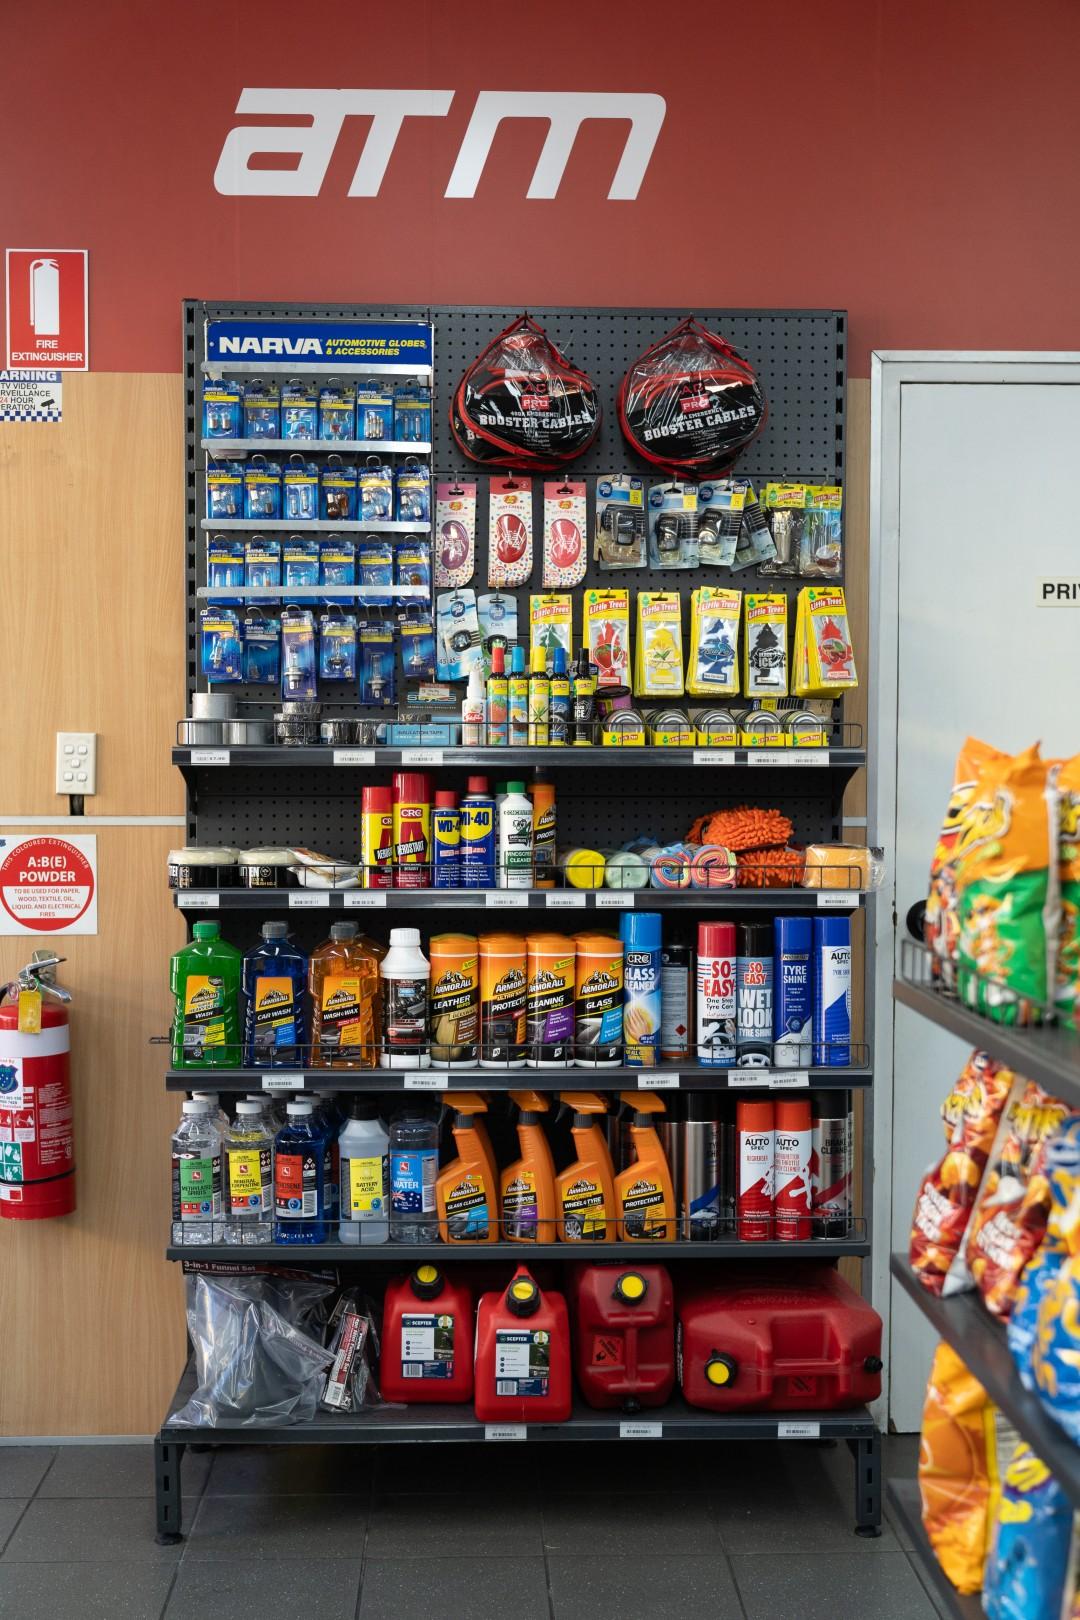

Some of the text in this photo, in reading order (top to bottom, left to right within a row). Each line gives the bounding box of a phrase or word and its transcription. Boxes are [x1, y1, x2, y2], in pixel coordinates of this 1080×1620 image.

[36, 340, 58, 349] FIRE
[219, 336, 323, 355] NARVA
[326, 339, 426, 348] AUTOMOTIVE GLOBES
[12, 352, 83, 362] EXTINGUISHER
[326, 347, 400, 356] & ACCESSORIES
[0, 370, 57, 382] ARNING
[523, 400, 549, 408] PRO
[479, 414, 593, 429] BOOSTER CABLES
[643, 405, 756, 442] BOOSTER CABLES
[589, 600, 626, 615] Little Trees
[642, 603, 678, 617] Little Trees
[701, 600, 739, 612] Little Trees
[810, 598, 843, 611] Little Trees
[532, 605, 571, 621] Little Trees
[748, 605, 786, 619] Little Trees
[574, 709, 585, 718] ICE
[401, 809, 422, 817] CRC
[382, 817, 392, 825] CR
[438, 819, 460, 833] WD-4
[2, 838, 90, 871] THIS COLOURED EXTINGUISHER
[27, 856, 67, 869] A:B(E)
[19, 871, 76, 883] POWDER
[627, 953, 651, 963] CRC
[624, 968, 655, 981] GLASS
[711, 961, 732, 979] SO
[749, 962, 764, 975] SO
[783, 965, 807, 975] TYRE
[624, 980, 656, 991] CLEANER
[744, 973, 767, 985] EASY
[783, 975, 807, 984] SHINE
[434, 979, 472, 994] ARMORALL
[495, 978, 527, 994] ARMORA
[528, 979, 564, 993] ARMORALL
[581, 979, 618, 994] ARMORALL
[703, 979, 735, 997] EASY
[433, 994, 471, 1010] LEATHER
[497, 993, 515, 1001] ULTRA
[528, 995, 564, 1010] CLEANING
[586, 998, 613, 1009] GLASS
[721, 997, 734, 1005] Step
[739, 989, 772, 1009] WET
[195, 1011, 214, 1019] WASH
[257, 1007, 292, 1021] CAR WASH
[323, 1007, 359, 1021] WASH WAX
[737, 1008, 773, 1028] LOOK
[739, 1028, 755, 1037] TYRE
[745, 1138, 770, 1146] AUTO
[776, 1139, 799, 1147] AUTO
[394, 1181, 419, 1189] WATER
[447, 1196, 484, 1210] GLASS CLEANER
[564, 1196, 602, 1209] WHEEL TYRE
[625, 1196, 661, 1208] PROTECTANT
[184, 1260, 209, 1270] 3-in-1
